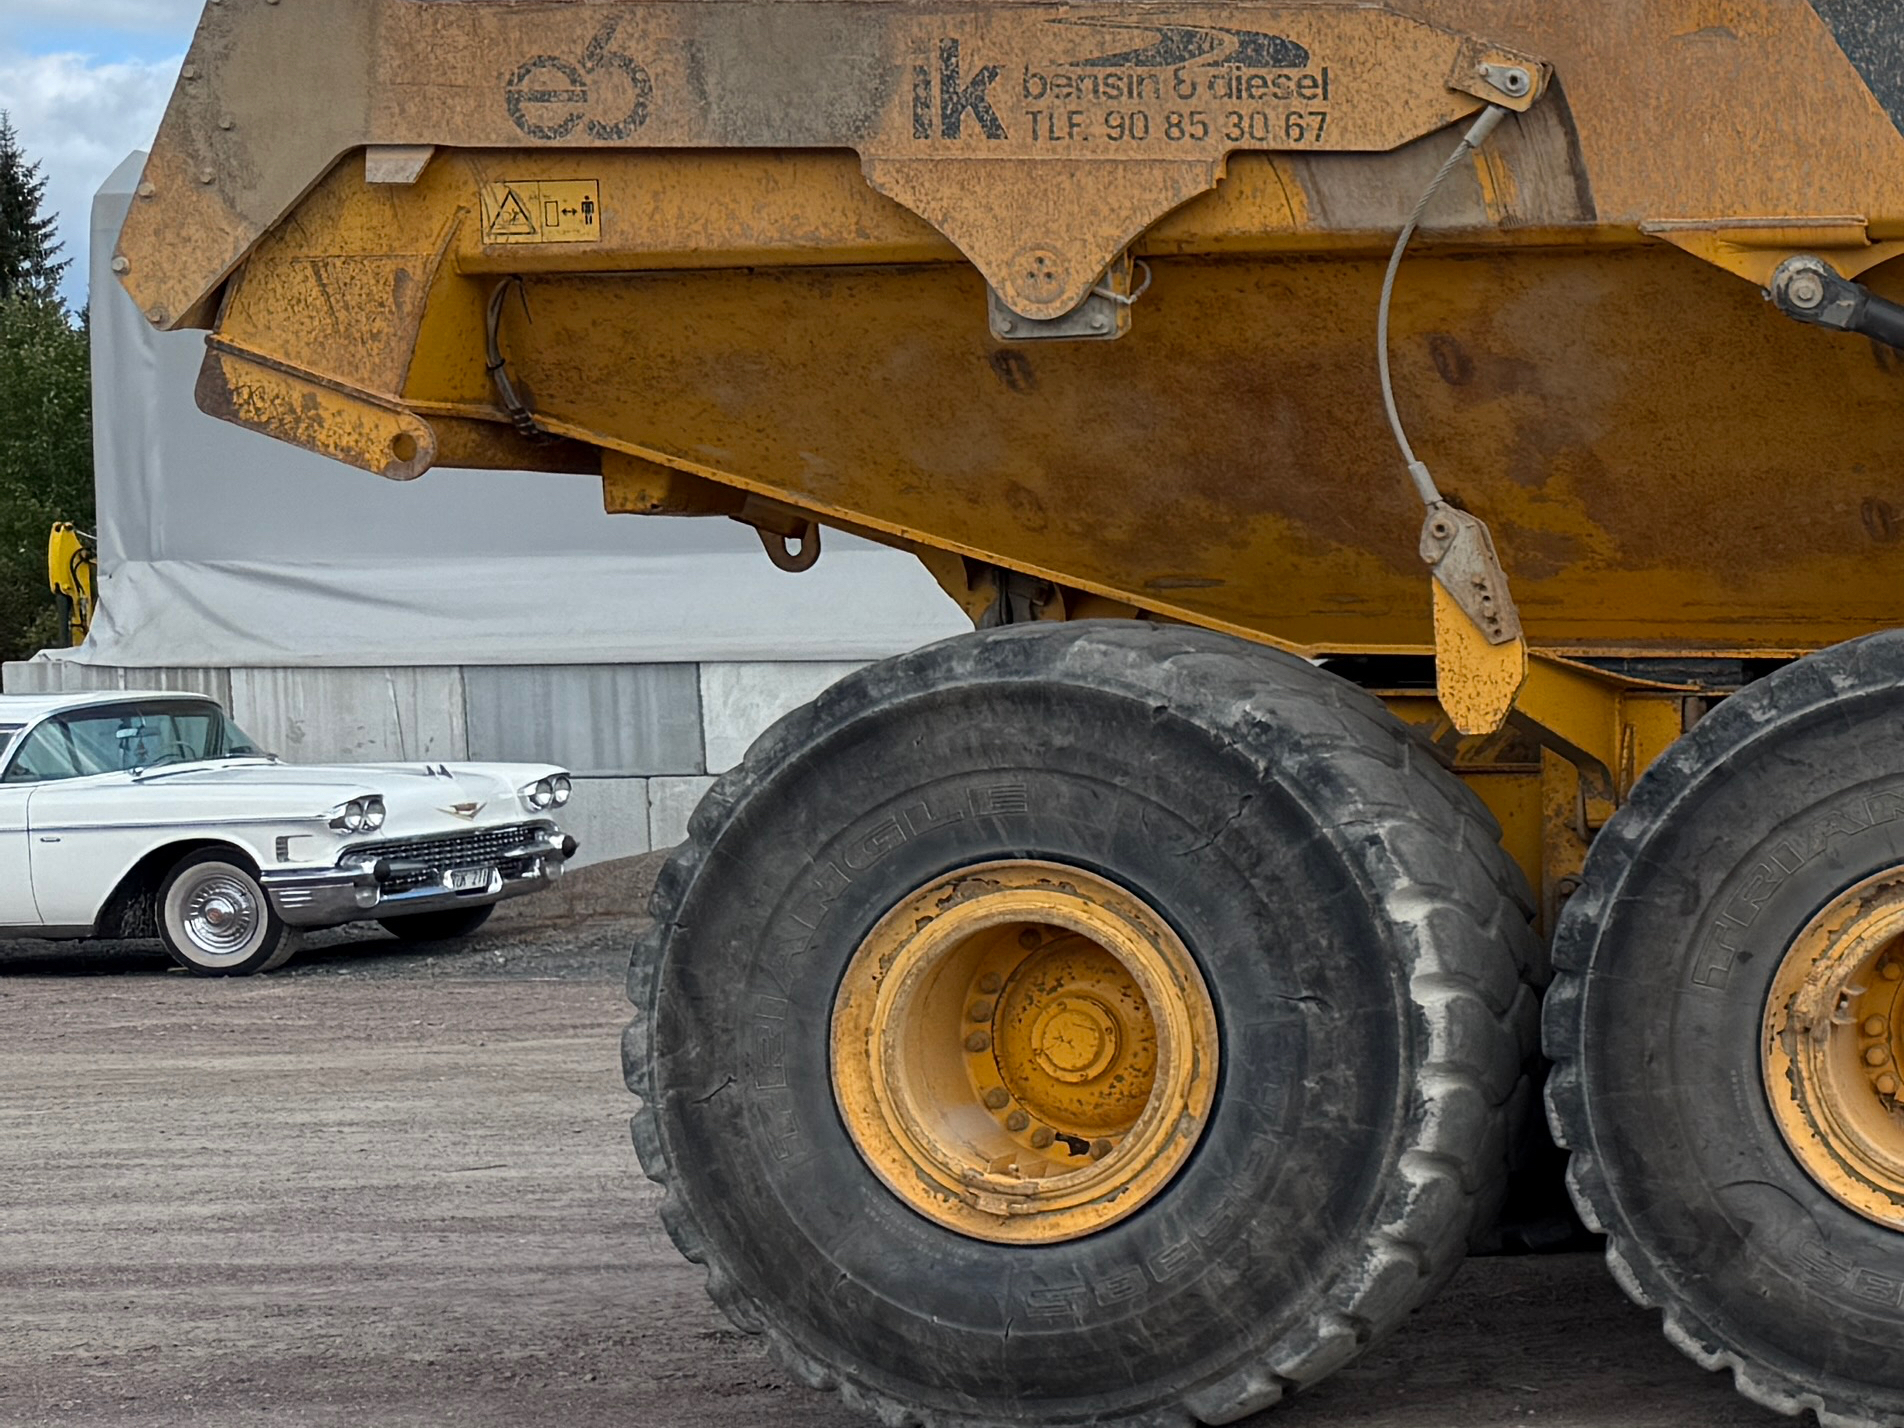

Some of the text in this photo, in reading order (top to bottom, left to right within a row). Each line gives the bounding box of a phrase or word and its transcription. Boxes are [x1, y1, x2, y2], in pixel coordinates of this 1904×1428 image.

[1022, 66, 1161, 101] bensin
[1207, 66, 1330, 102] diesel
[1104, 110, 1150, 142] 90
[1163, 110, 1210, 142] 85
[1225, 110, 1270, 142] 30
[1283, 110, 1329, 142] 67
[755, 783, 1028, 1160] TRIANGLE
